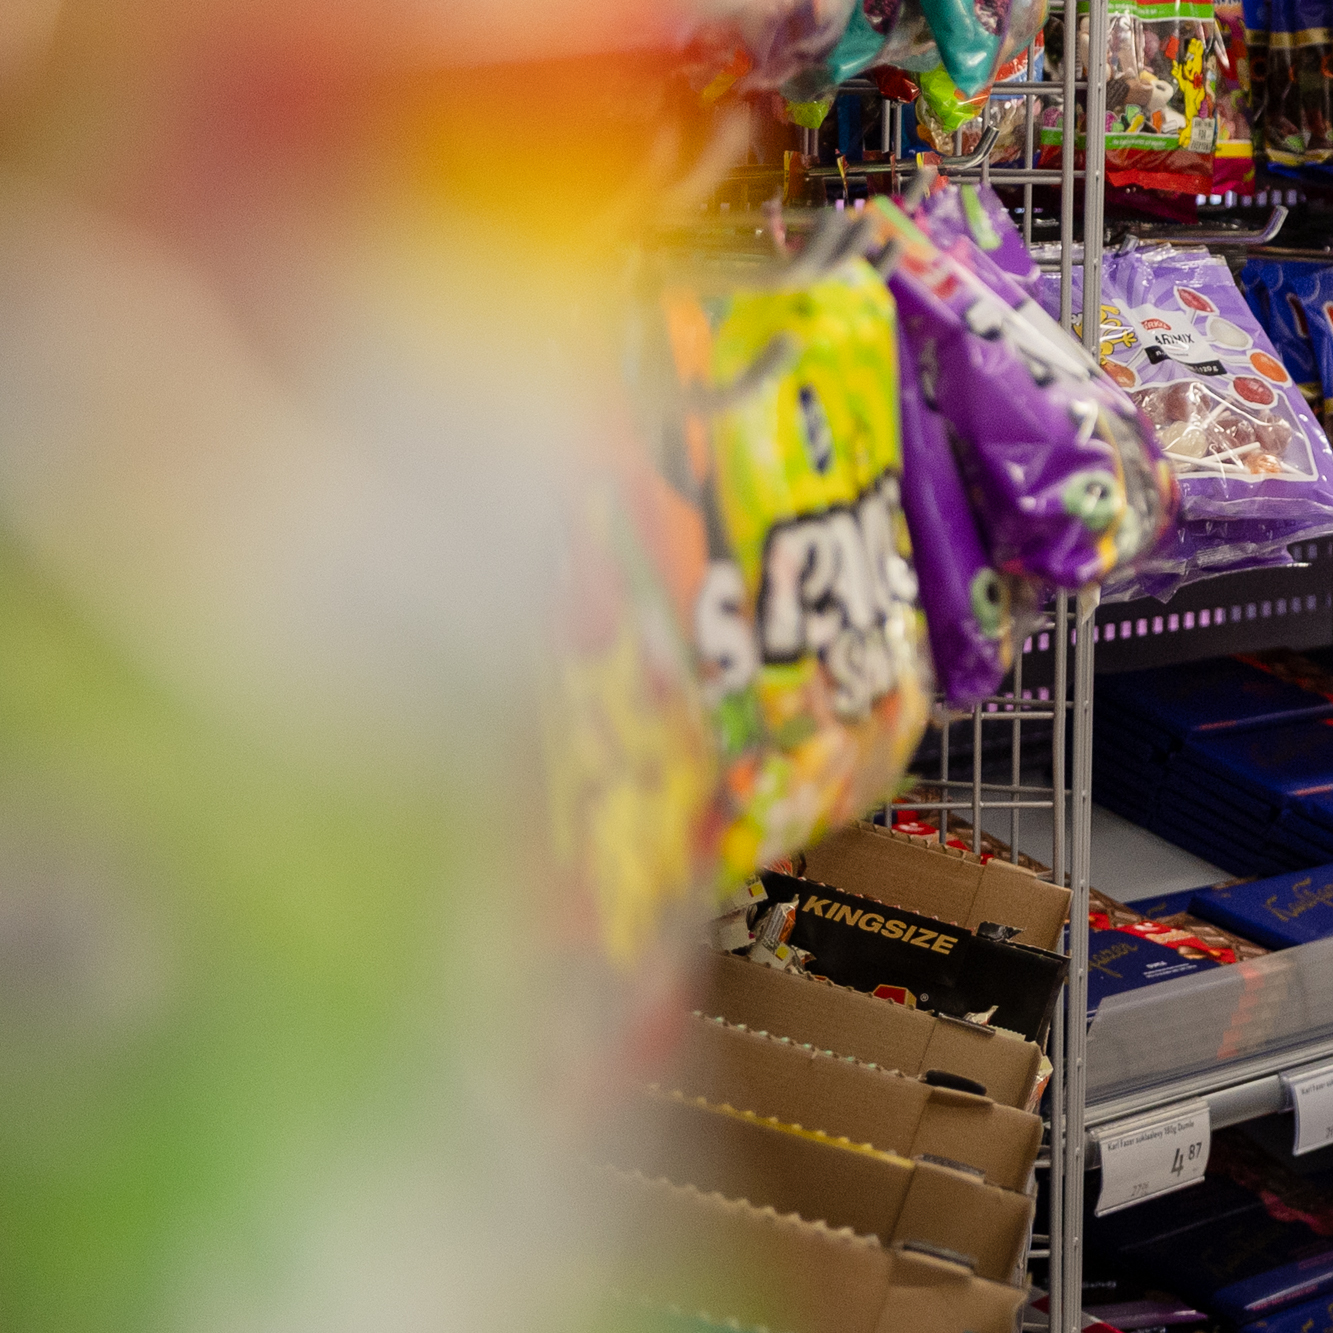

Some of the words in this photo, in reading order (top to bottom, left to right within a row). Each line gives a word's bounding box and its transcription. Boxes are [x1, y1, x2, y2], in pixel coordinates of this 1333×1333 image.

[802, 895, 959, 955] KINGSIZE
[1108, 1139, 1119, 1151] Karl
[1120, 1137, 1134, 1147] Fazer
[1135, 1131, 1163, 1144] suklaalevy
[1177, 1119, 1194, 1131] Dumle
[1171, 1148, 1184, 1177] 4
[1188, 1142, 1202, 1160] 87
